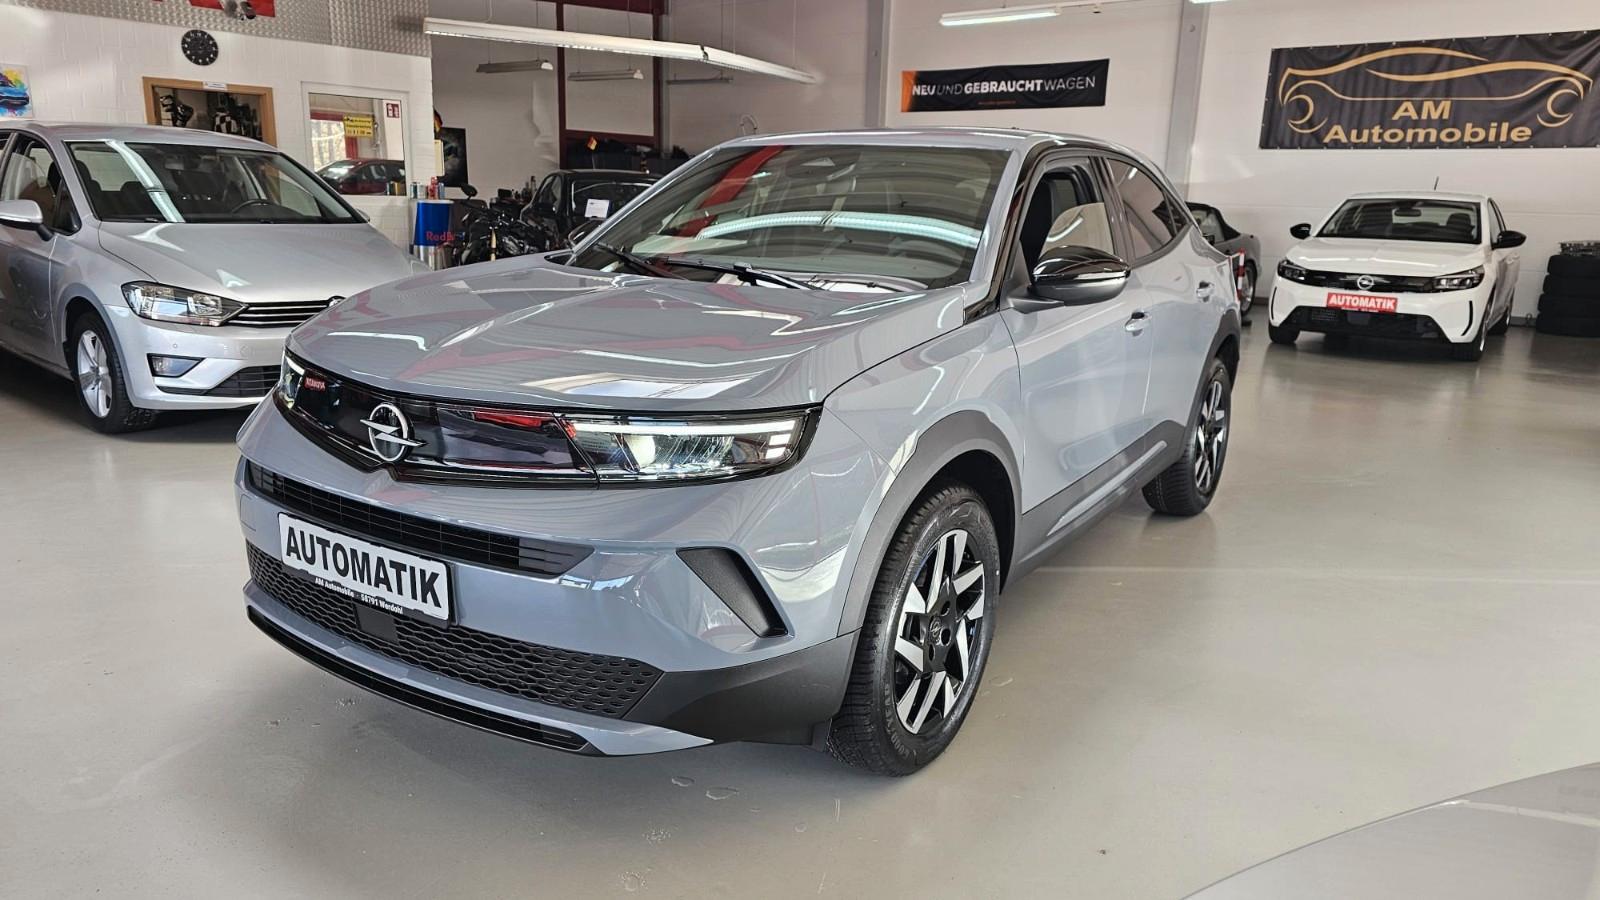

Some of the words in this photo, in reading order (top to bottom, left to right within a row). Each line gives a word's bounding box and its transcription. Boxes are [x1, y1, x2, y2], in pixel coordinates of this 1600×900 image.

[1391, 100, 1452, 120] AM
[1323, 122, 1532, 143] Automobile
[1328, 294, 1395, 310] AUTOMATIK
[286, 526, 442, 609] AUTOMATIK
